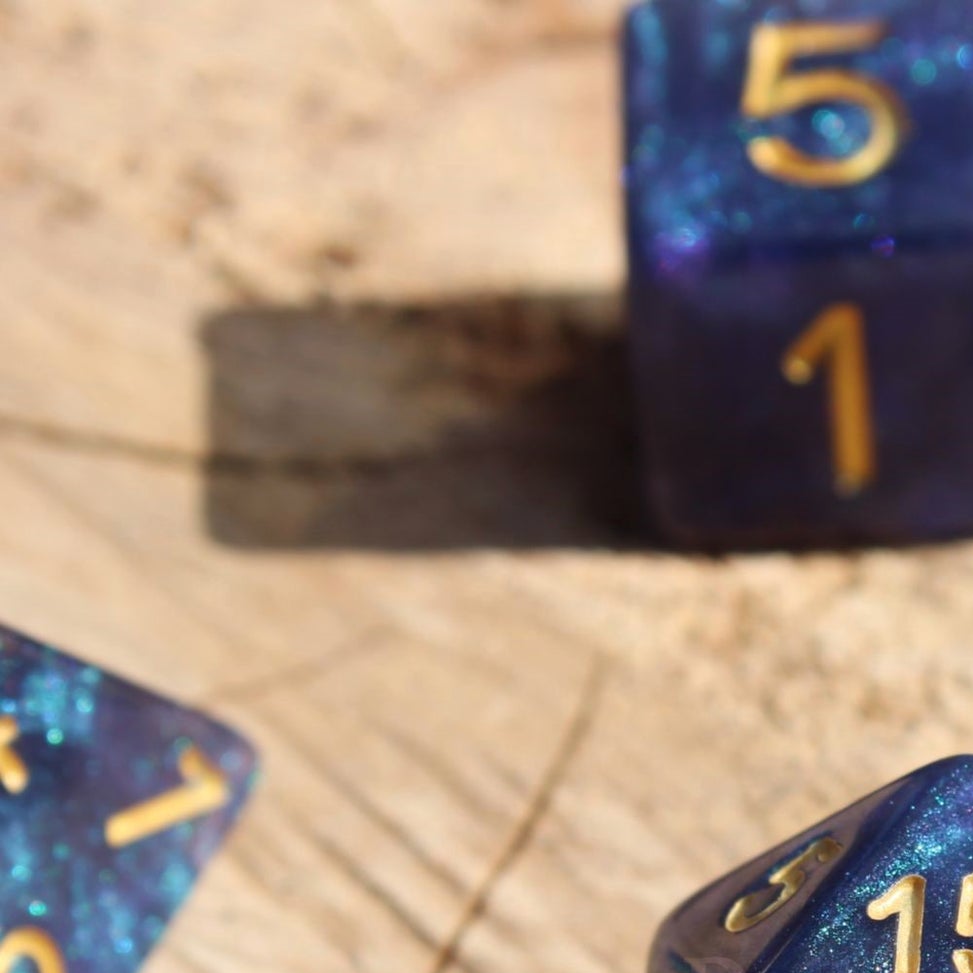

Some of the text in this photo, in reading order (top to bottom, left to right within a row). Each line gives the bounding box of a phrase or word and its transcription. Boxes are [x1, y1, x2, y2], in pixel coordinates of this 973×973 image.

[741, 20, 908, 187] 5
[780, 303, 874, 495] 1
[104, 746, 230, 848] 1
